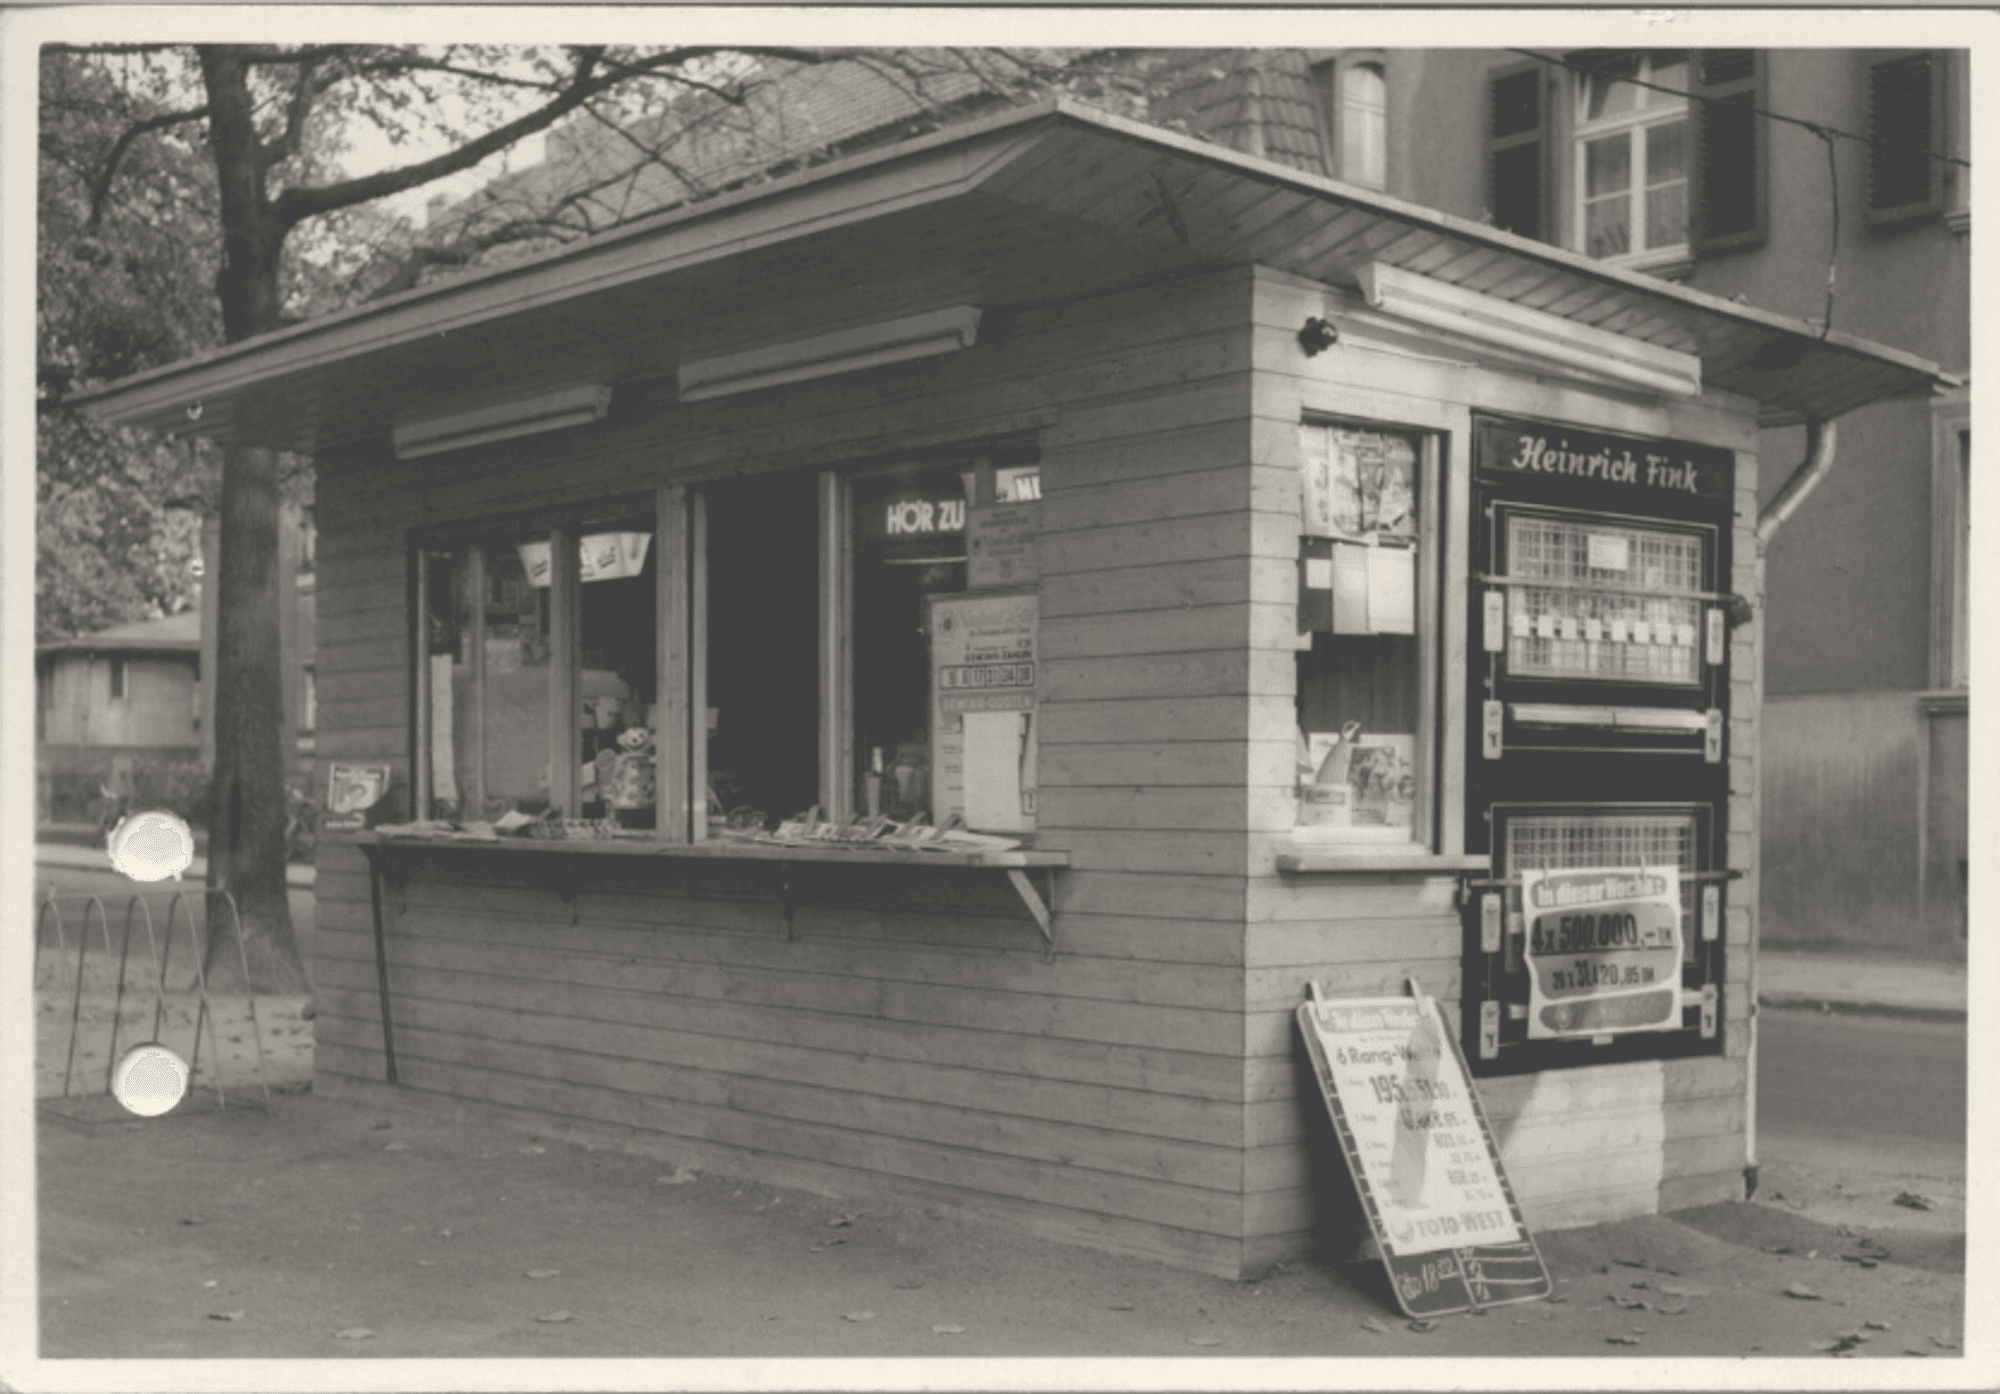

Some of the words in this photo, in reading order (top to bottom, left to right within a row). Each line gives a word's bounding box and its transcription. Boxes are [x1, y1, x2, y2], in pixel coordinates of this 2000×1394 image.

[1512, 435, 1638, 484] Heinrich
[1644, 453, 1699, 493] Fink
[886, 499, 935, 535] HÖR
[937, 498, 966, 532] ZU
[1557, 881, 1604, 904] dieser
